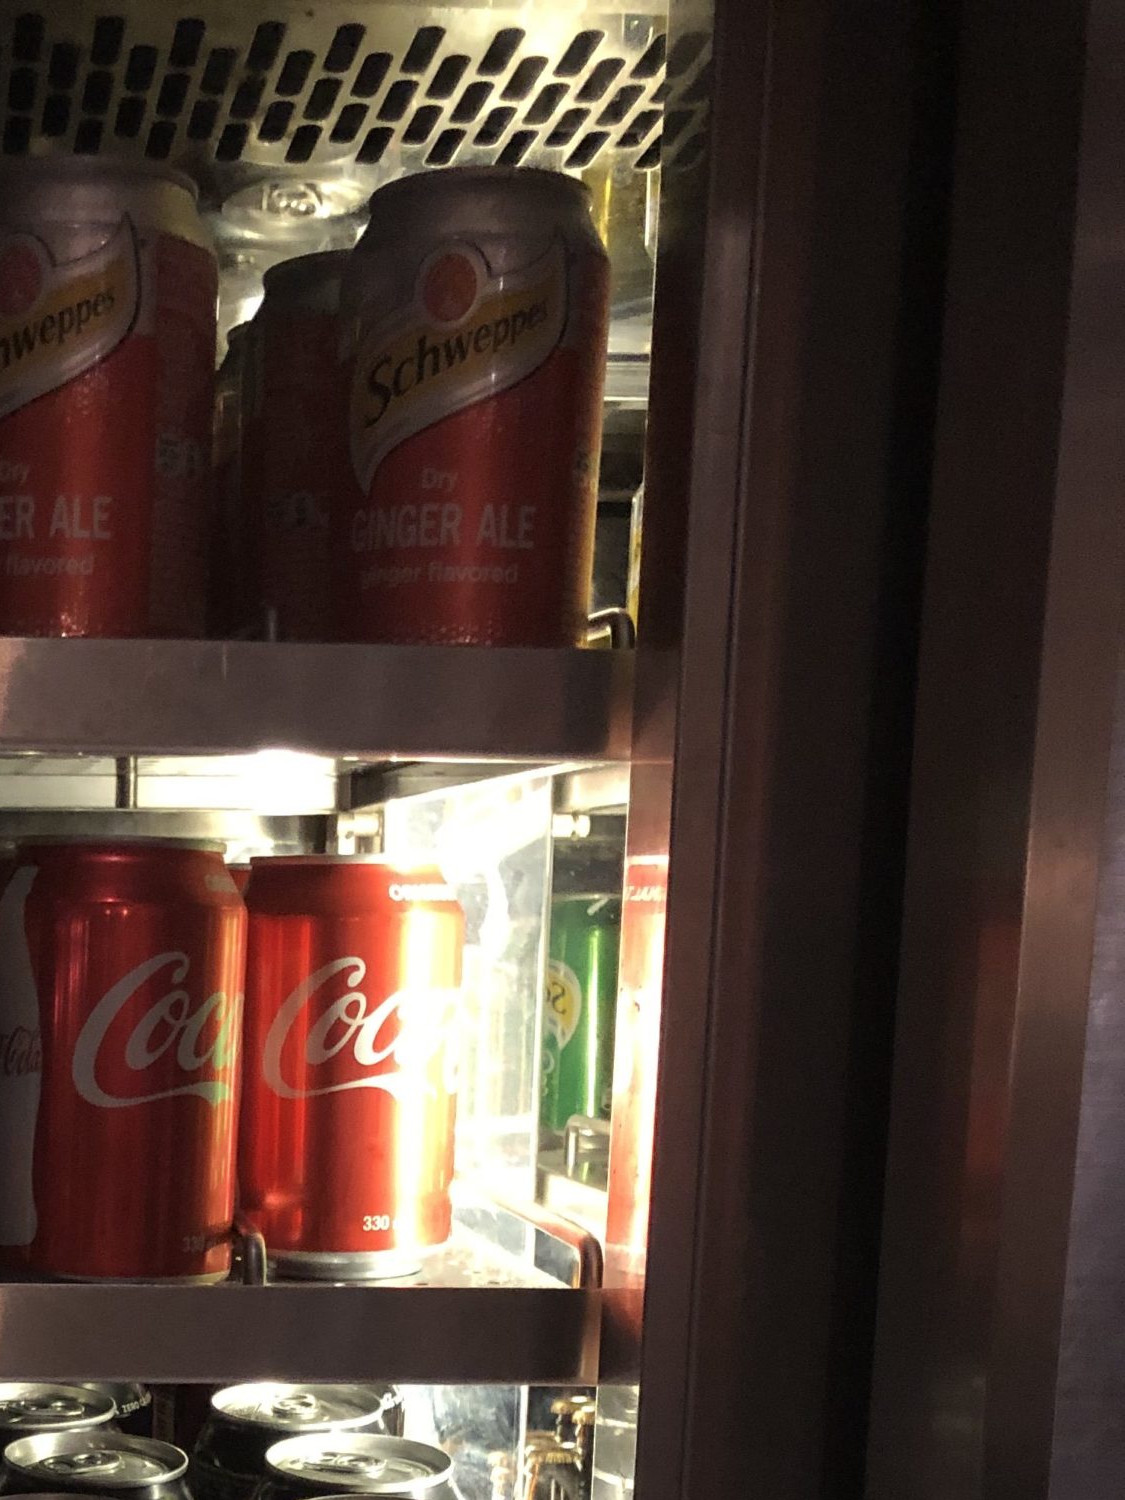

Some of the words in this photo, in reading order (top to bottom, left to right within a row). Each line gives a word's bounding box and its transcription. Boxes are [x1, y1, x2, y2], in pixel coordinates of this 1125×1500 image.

[363, 300, 550, 430] Schweppes
[421, 468, 460, 493] Dry
[49, 496, 115, 541] ALE
[475, 504, 537, 550] ALE
[362, 1214, 390, 1232] 330
